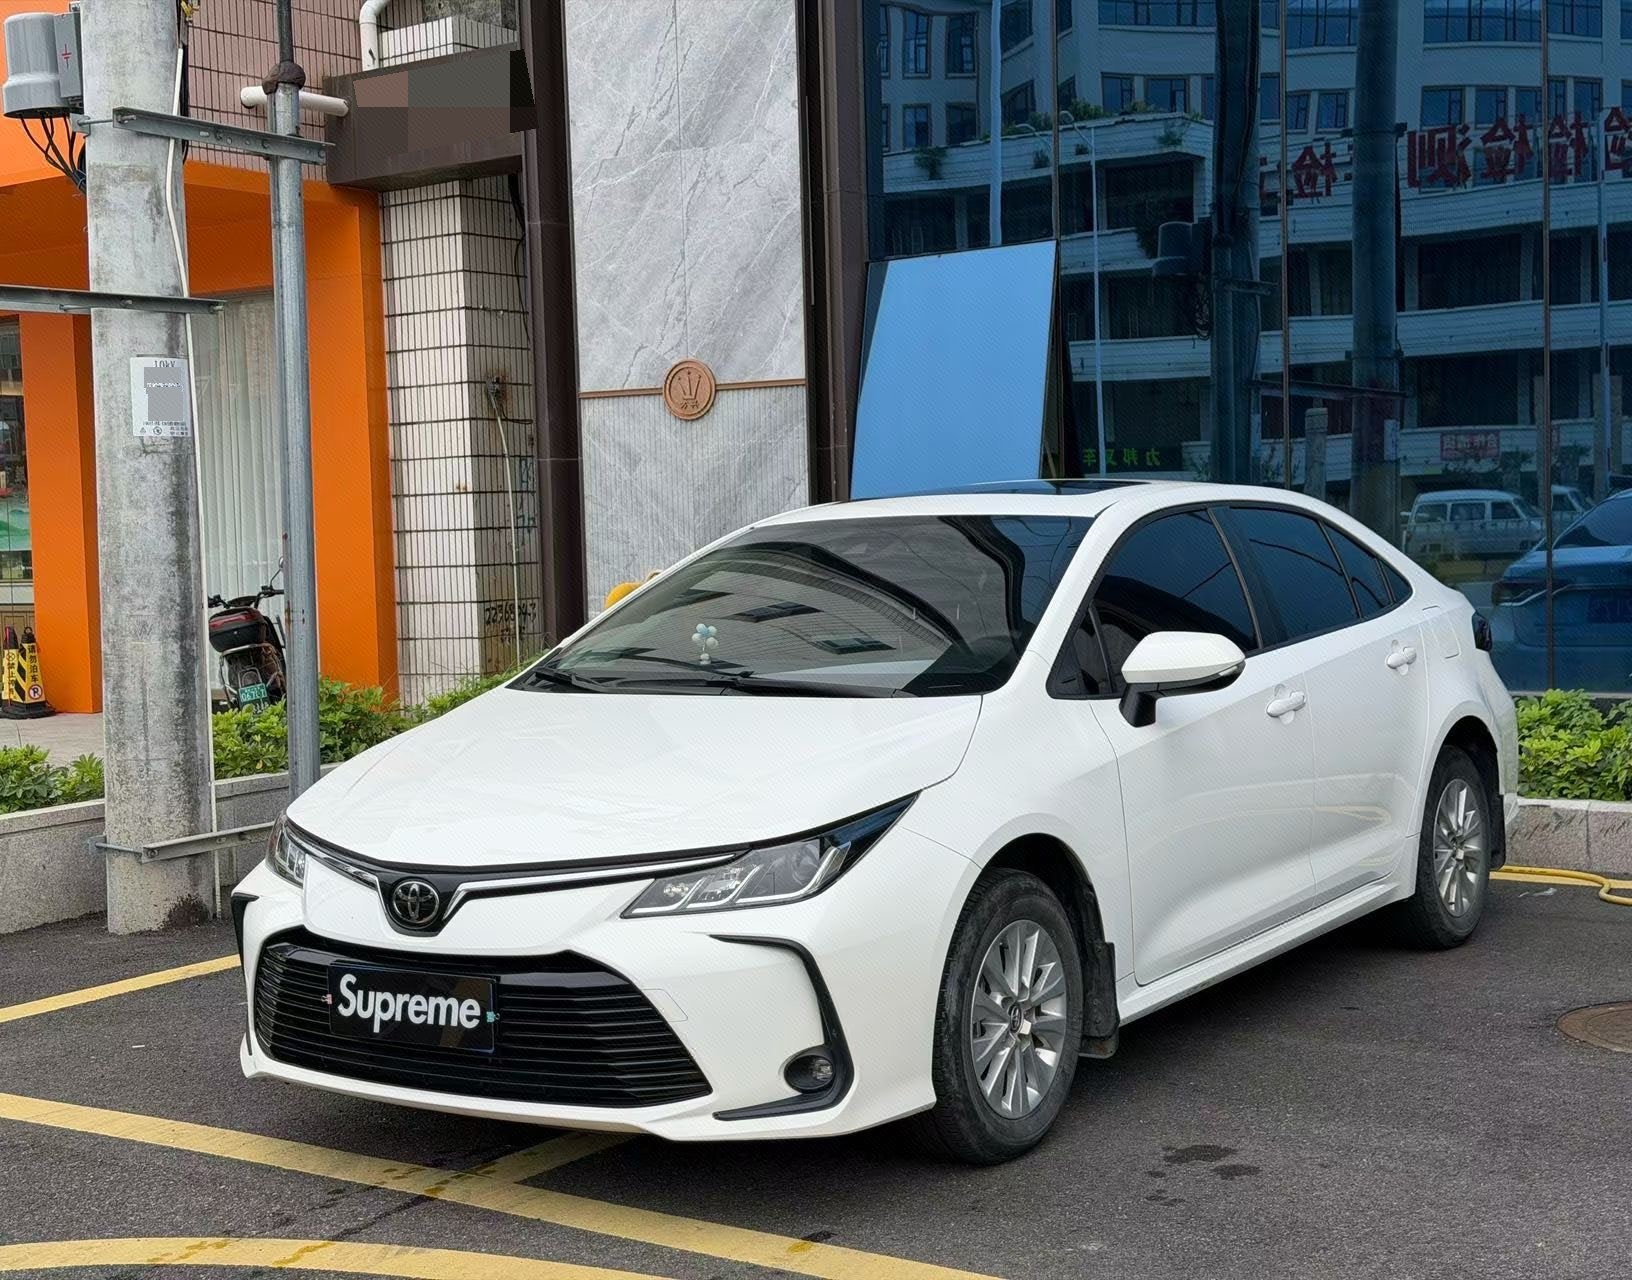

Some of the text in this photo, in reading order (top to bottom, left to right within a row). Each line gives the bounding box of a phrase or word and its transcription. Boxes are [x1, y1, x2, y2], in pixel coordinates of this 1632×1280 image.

[27, 645, 39, 683] 请勿泊车
[337, 974, 481, 1033] Supreme
